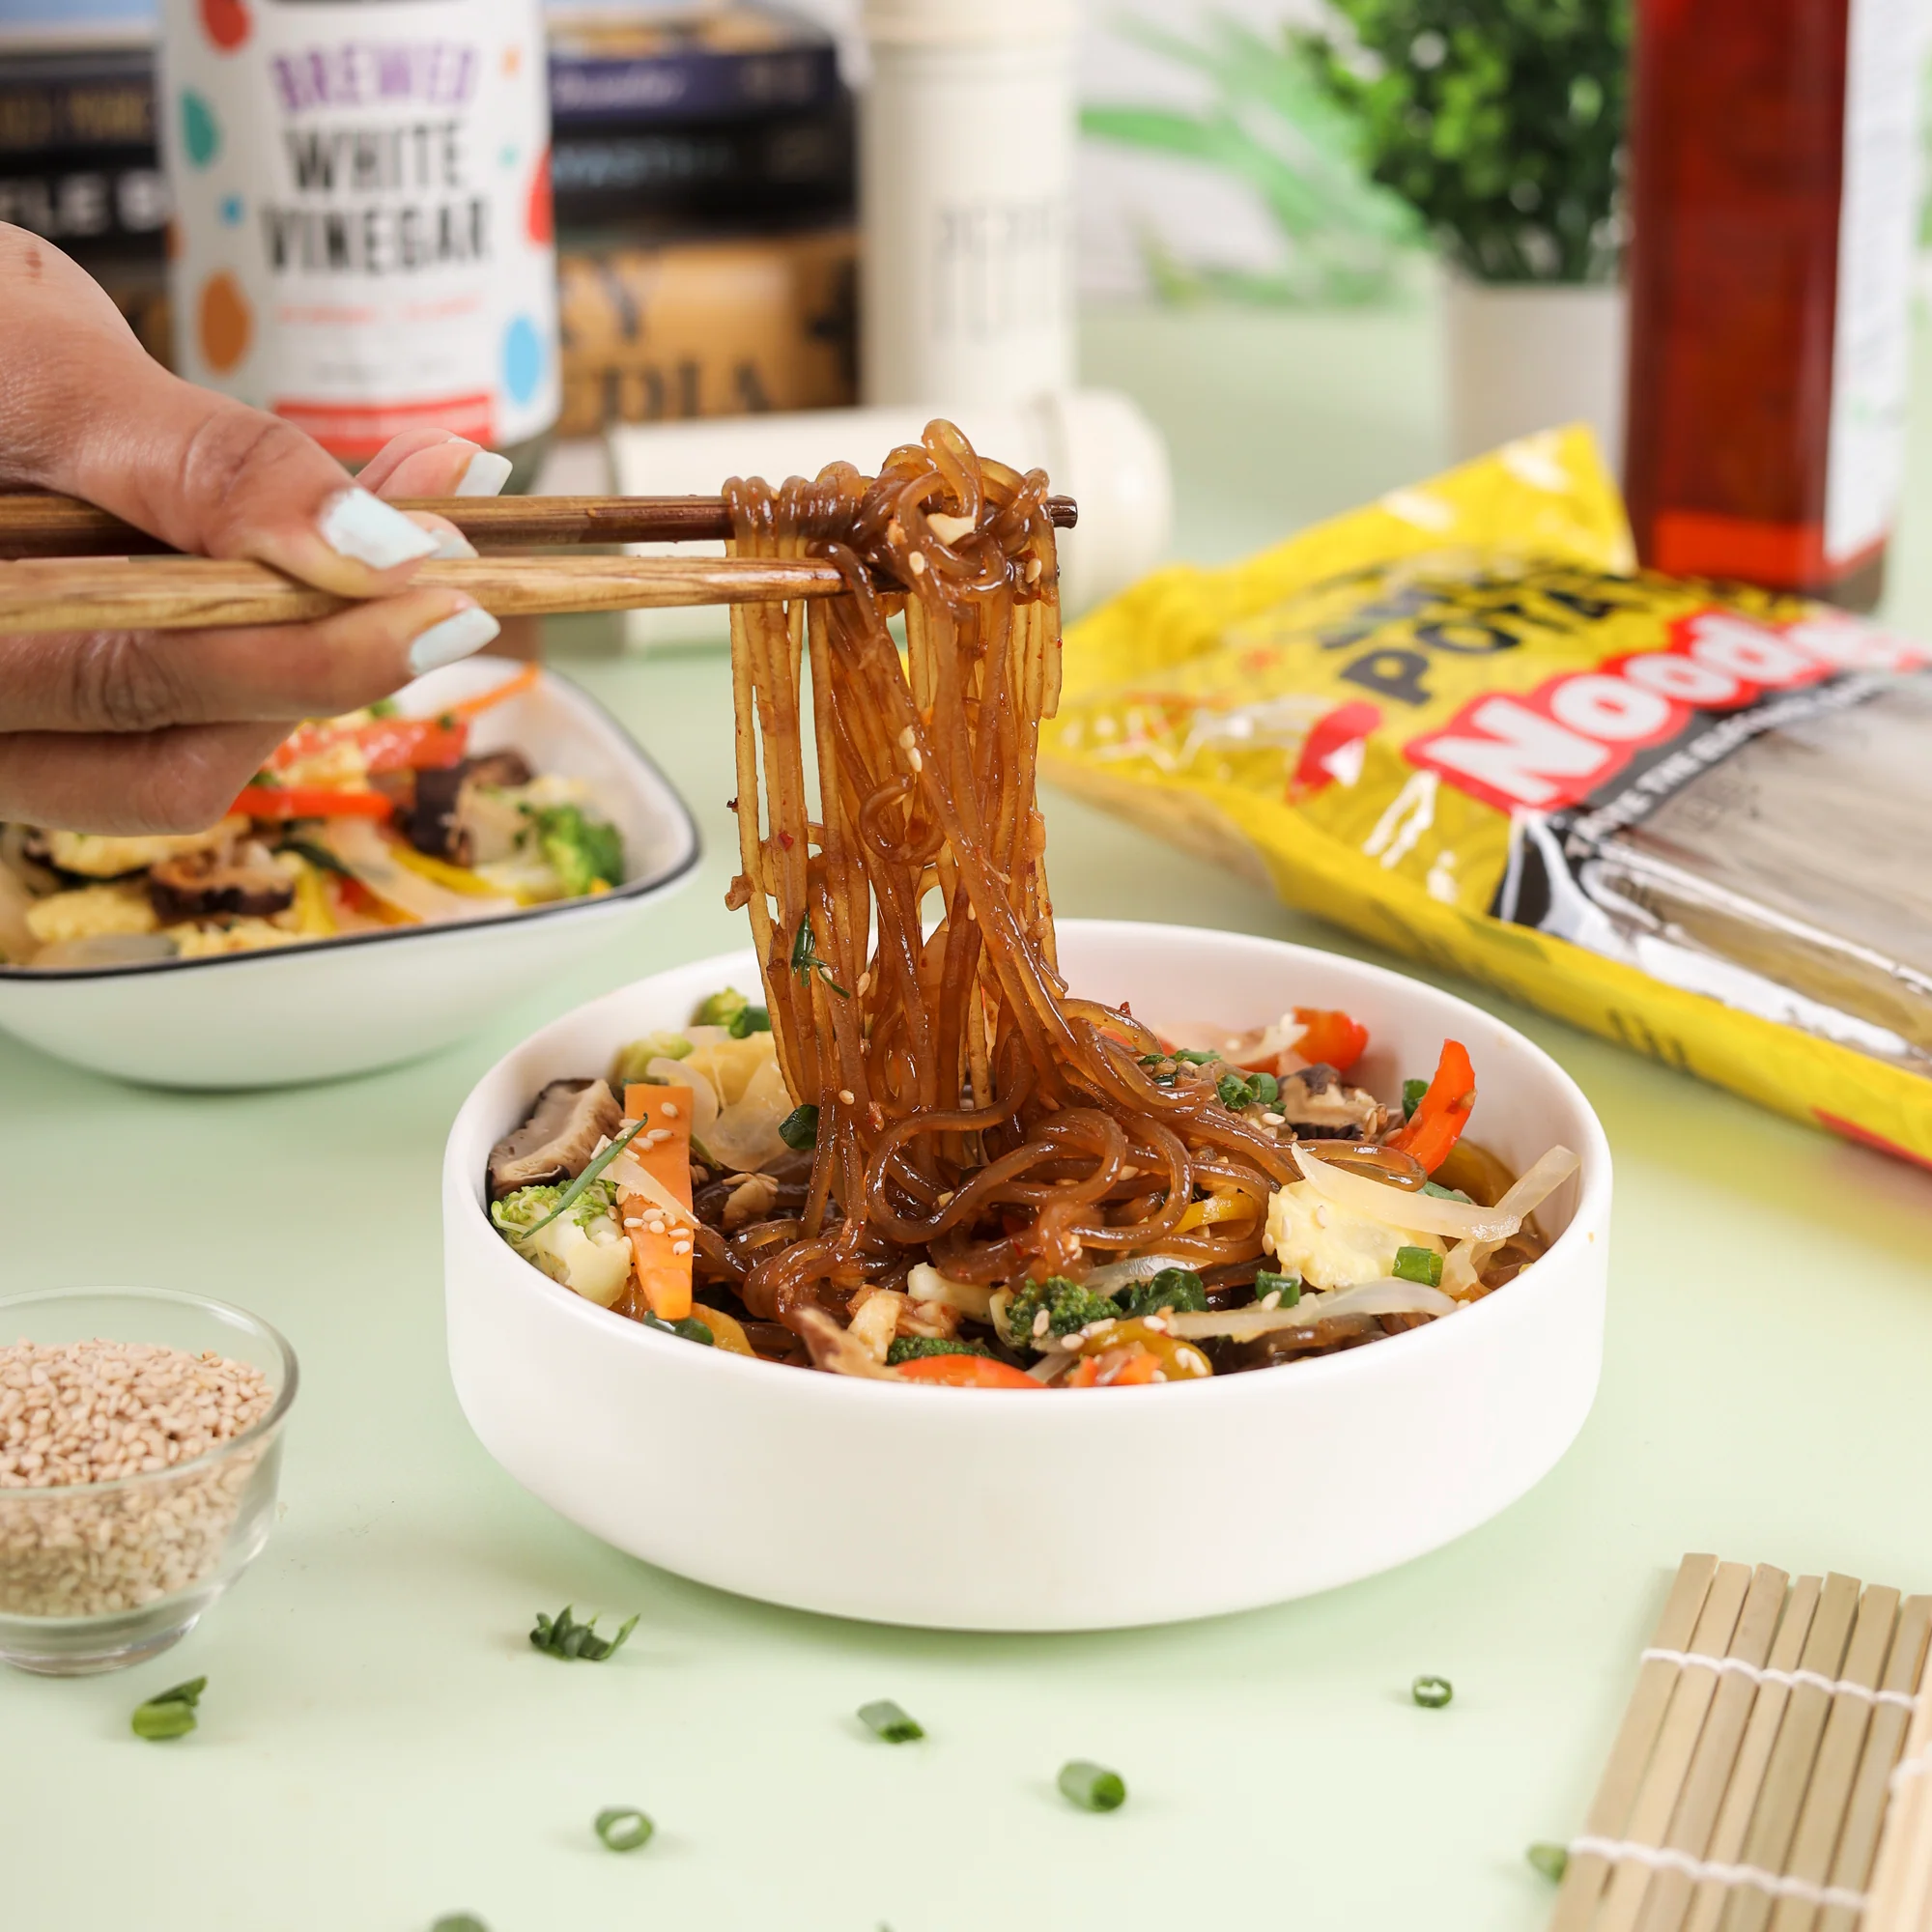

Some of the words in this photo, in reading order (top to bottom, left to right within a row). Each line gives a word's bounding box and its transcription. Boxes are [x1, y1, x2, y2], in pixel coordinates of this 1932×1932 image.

[272, 42, 478, 111] BREWED
[284, 121, 465, 189] WHITE
[261, 198, 490, 274] VINEGAR
